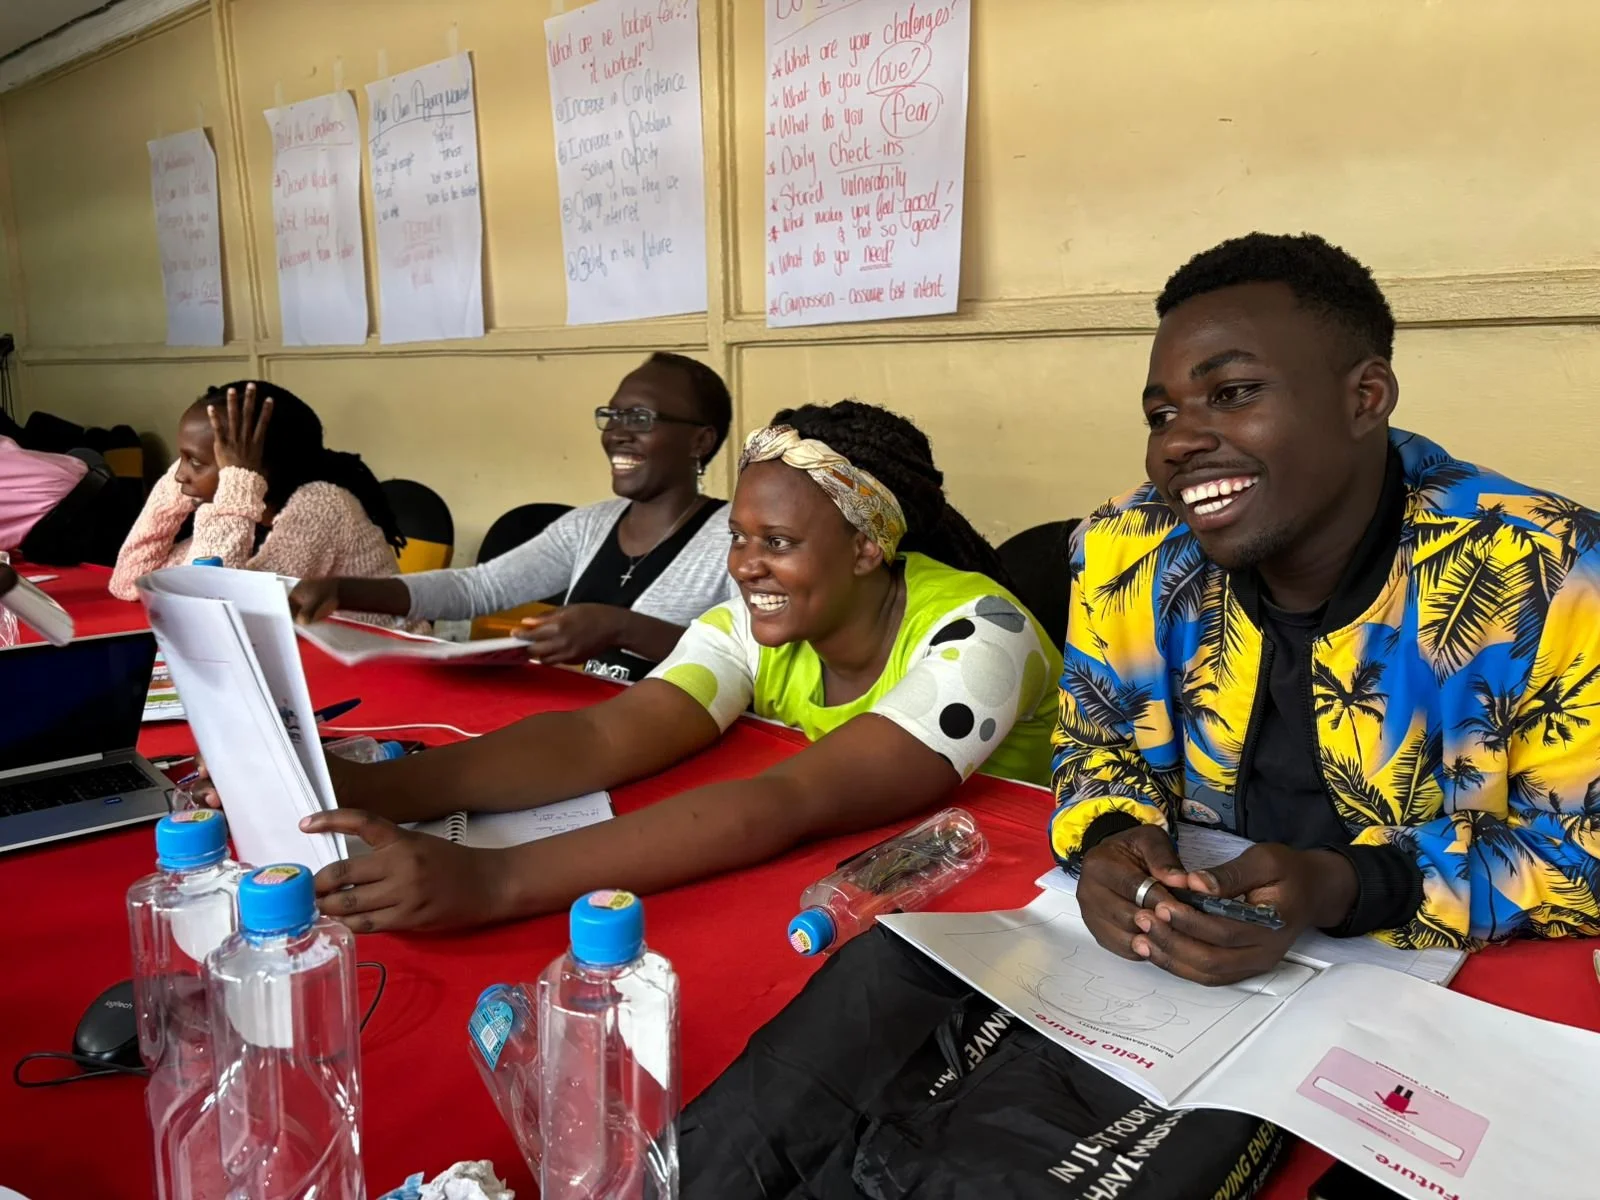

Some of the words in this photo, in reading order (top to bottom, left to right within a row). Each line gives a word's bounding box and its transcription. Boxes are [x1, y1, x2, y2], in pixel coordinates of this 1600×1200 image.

[548, 32, 573, 67] What
[784, 45, 810, 75] What
[820, 39, 838, 60] are
[850, 32, 872, 67] your
[783, 81, 808, 108] What
[819, 72, 831, 97] do
[838, 72, 860, 104] you
[780, 113, 808, 139] What
[822, 107, 834, 131] do
[840, 108, 863, 143] you
[782, 145, 816, 188] Daily
[780, 180, 824, 211] Shared
[783, 212, 804, 232] What
[852, 203, 870, 228] you
[876, 192, 895, 221] feel
[857, 221, 872, 239] not
[813, 243, 825, 266] do
[834, 249, 849, 276] you
[849, 286, 884, 304] assume
[889, 278, 905, 301] best
[913, 273, 946, 299] intent
[1102, 1044, 1155, 1069] Hello
[1048, 1160, 1085, 1183] IN
[1105, 1109, 1155, 1137] FOUR
